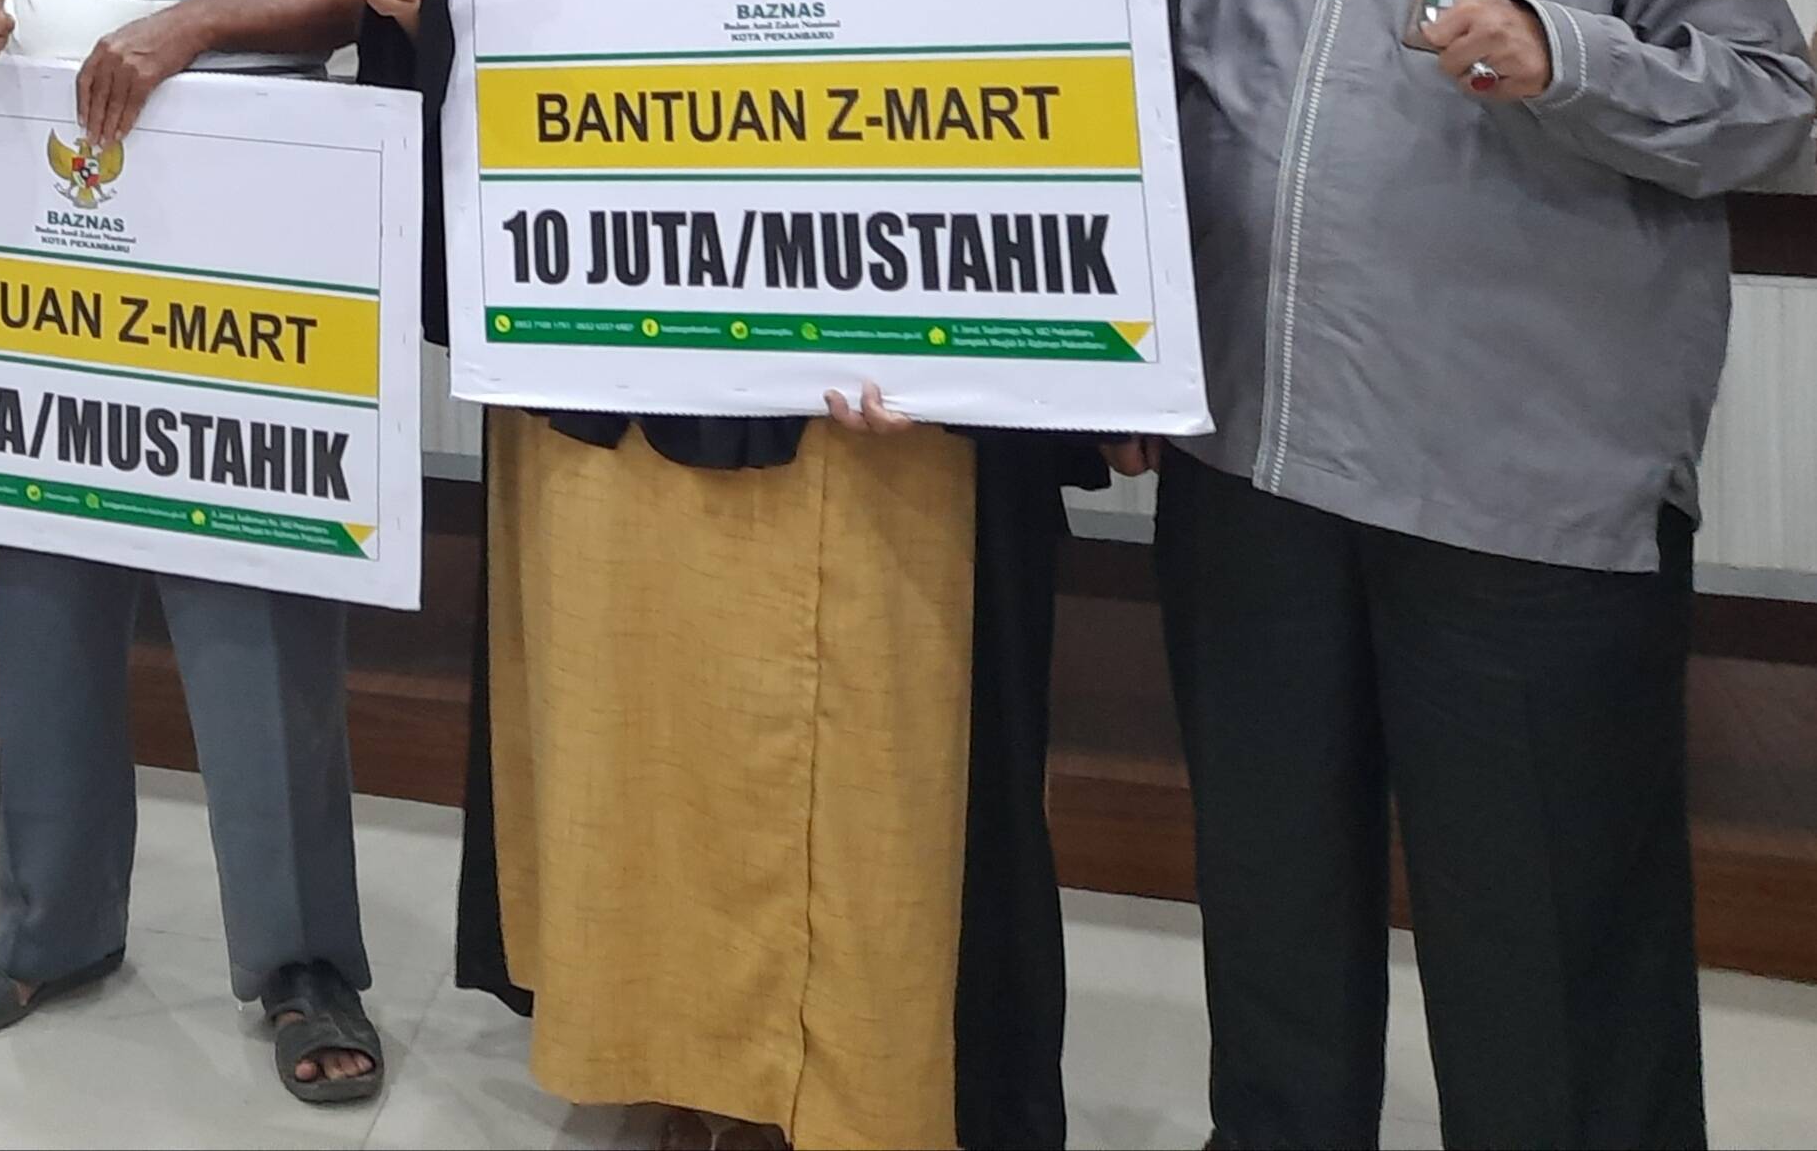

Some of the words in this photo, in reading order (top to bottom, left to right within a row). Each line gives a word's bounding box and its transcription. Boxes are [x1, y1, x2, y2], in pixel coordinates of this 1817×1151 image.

[735, 1, 826, 20] BAZNAS
[537, 90, 806, 143] BANTUAN
[827, 86, 1060, 141] Z-MART
[47, 210, 125, 232] BAZNAS
[502, 209, 570, 285] 10
[586, 210, 1118, 295] JUTA/MUSTAHIK
[118, 295, 318, 365] Z-MART
